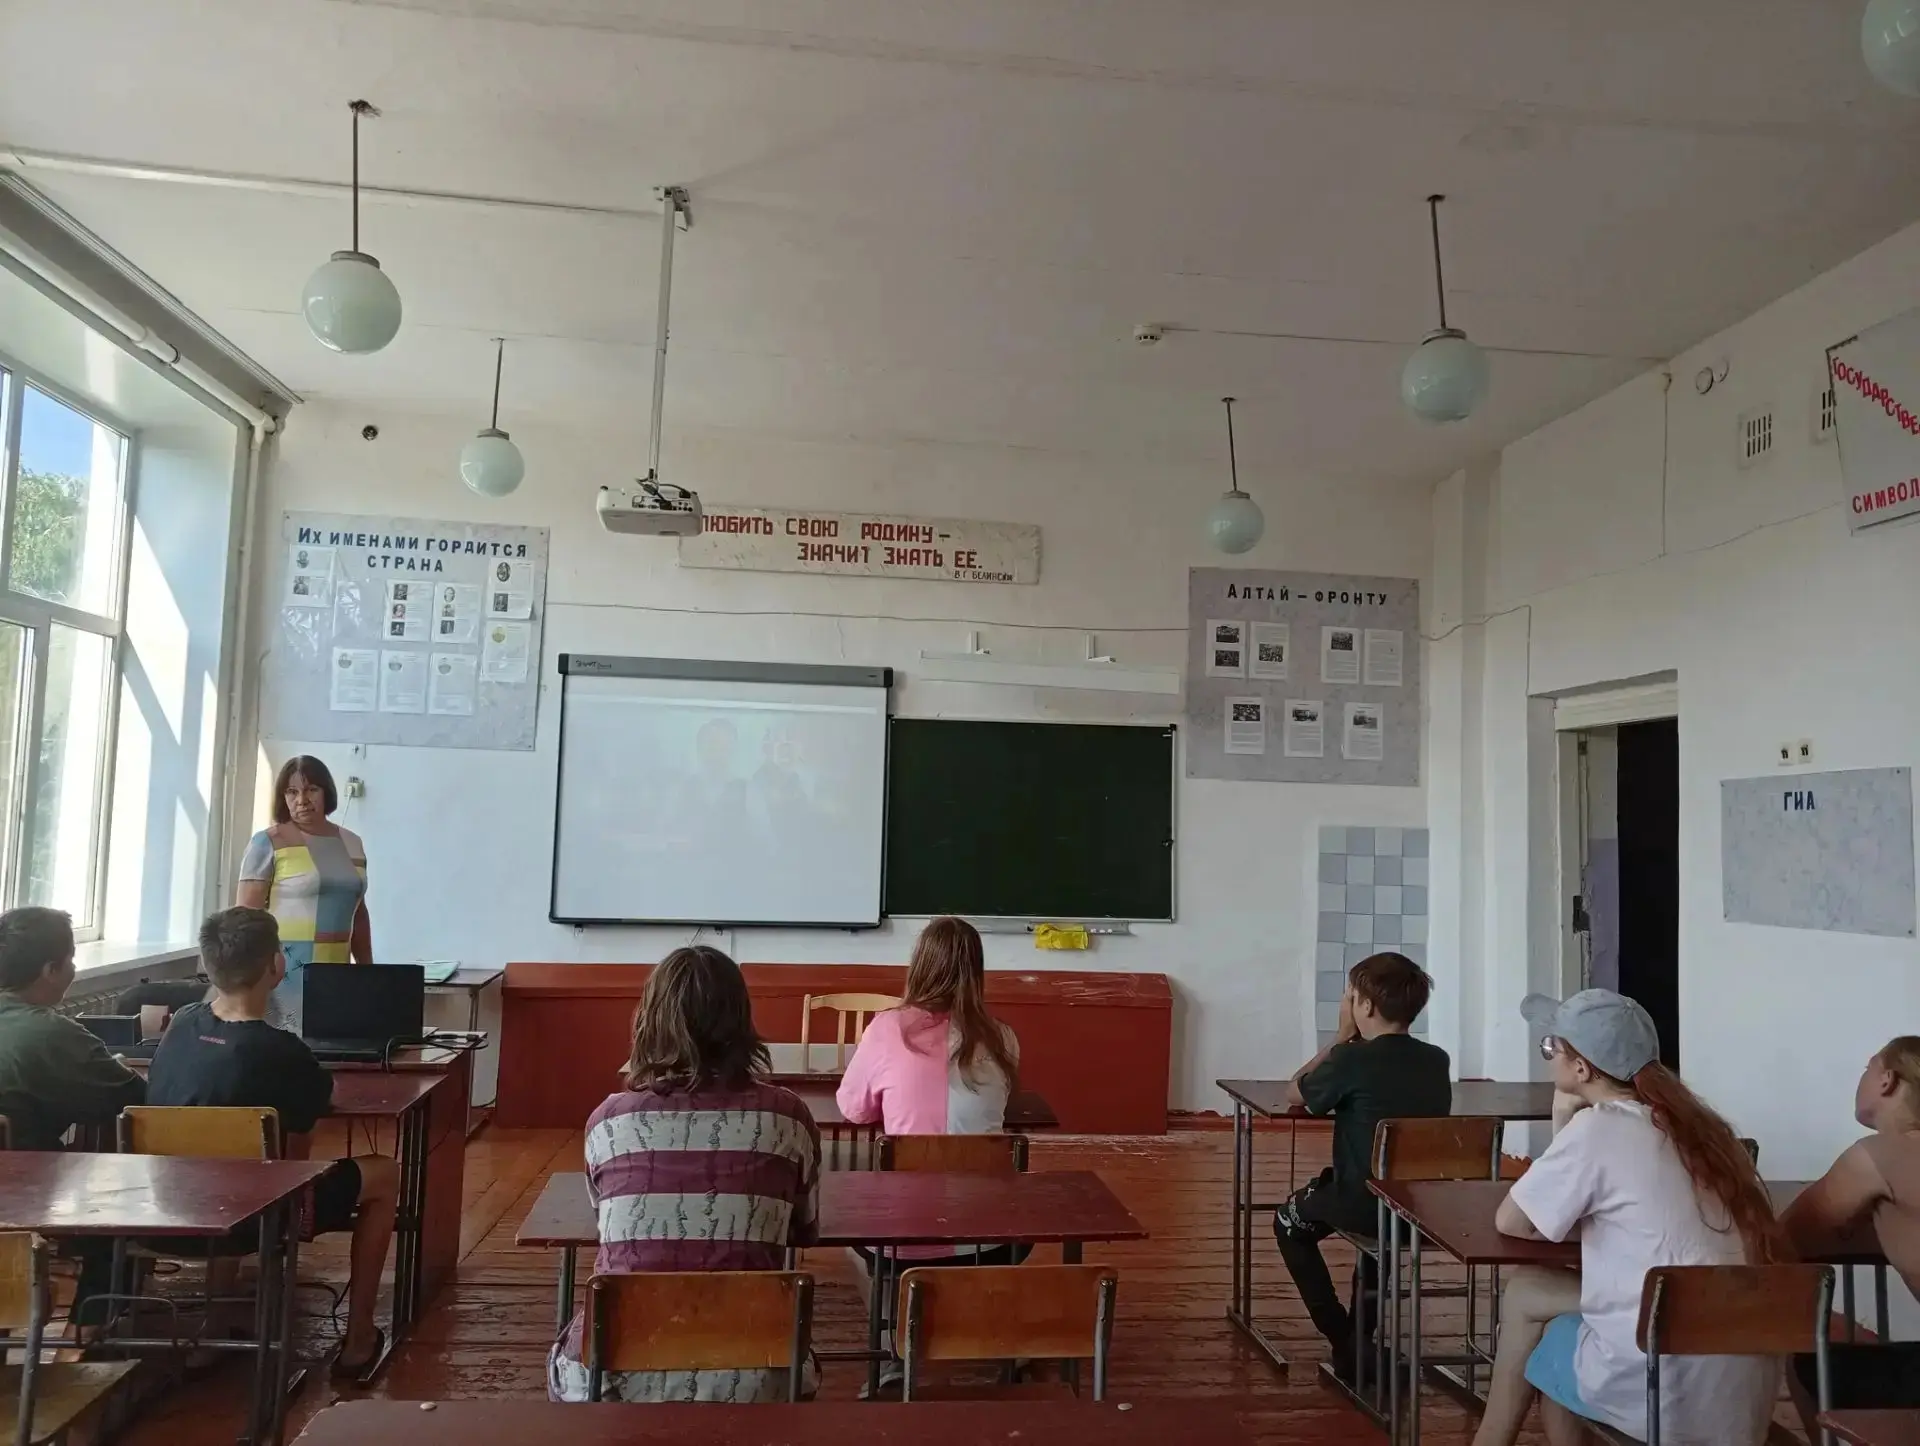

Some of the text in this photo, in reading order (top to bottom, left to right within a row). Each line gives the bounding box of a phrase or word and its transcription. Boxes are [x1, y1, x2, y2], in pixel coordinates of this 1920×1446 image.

[1831, 356, 1920, 436] ГОСУДАРСТВЕ
[1852, 478, 1920, 514] СИМВОЛ
[299, 528, 527, 557] ИХ ИМЕНАМИ ГОРДИТСЯ
[786, 518, 839, 538] СВОЮ
[861, 523, 933, 544] РОДИНУ
[367, 555, 444, 573] СТРАНА
[797, 542, 870, 564] ЗНАЧИТ
[883, 547, 944, 568] ЗНАТЬ
[1228, 583, 1289, 601] АЛТАЙ
[1315, 590, 1388, 606] ФРОНТУ
[1783, 790, 1816, 811] ГИА
